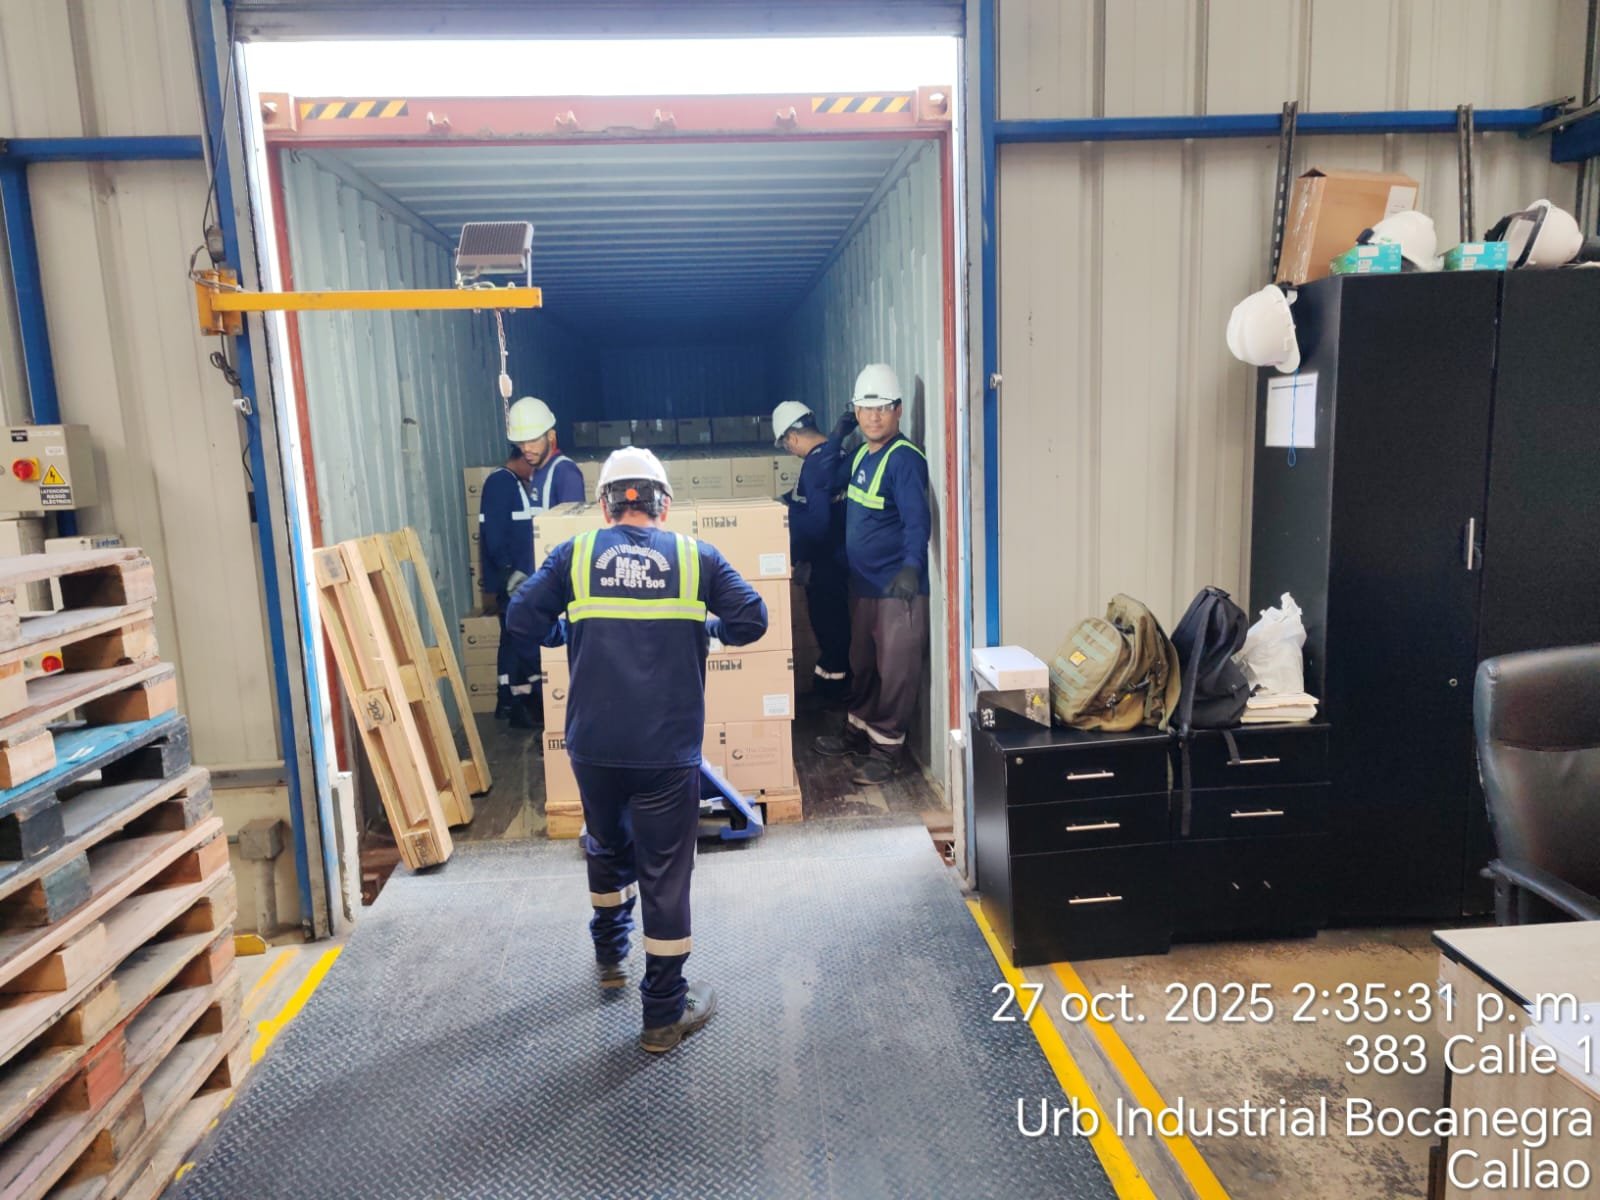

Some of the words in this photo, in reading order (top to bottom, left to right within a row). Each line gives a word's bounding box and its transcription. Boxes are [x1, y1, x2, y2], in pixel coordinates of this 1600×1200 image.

[616, 556, 651, 571] M&J
[615, 568, 651, 580] EIRL
[600, 577, 620, 586] 951
